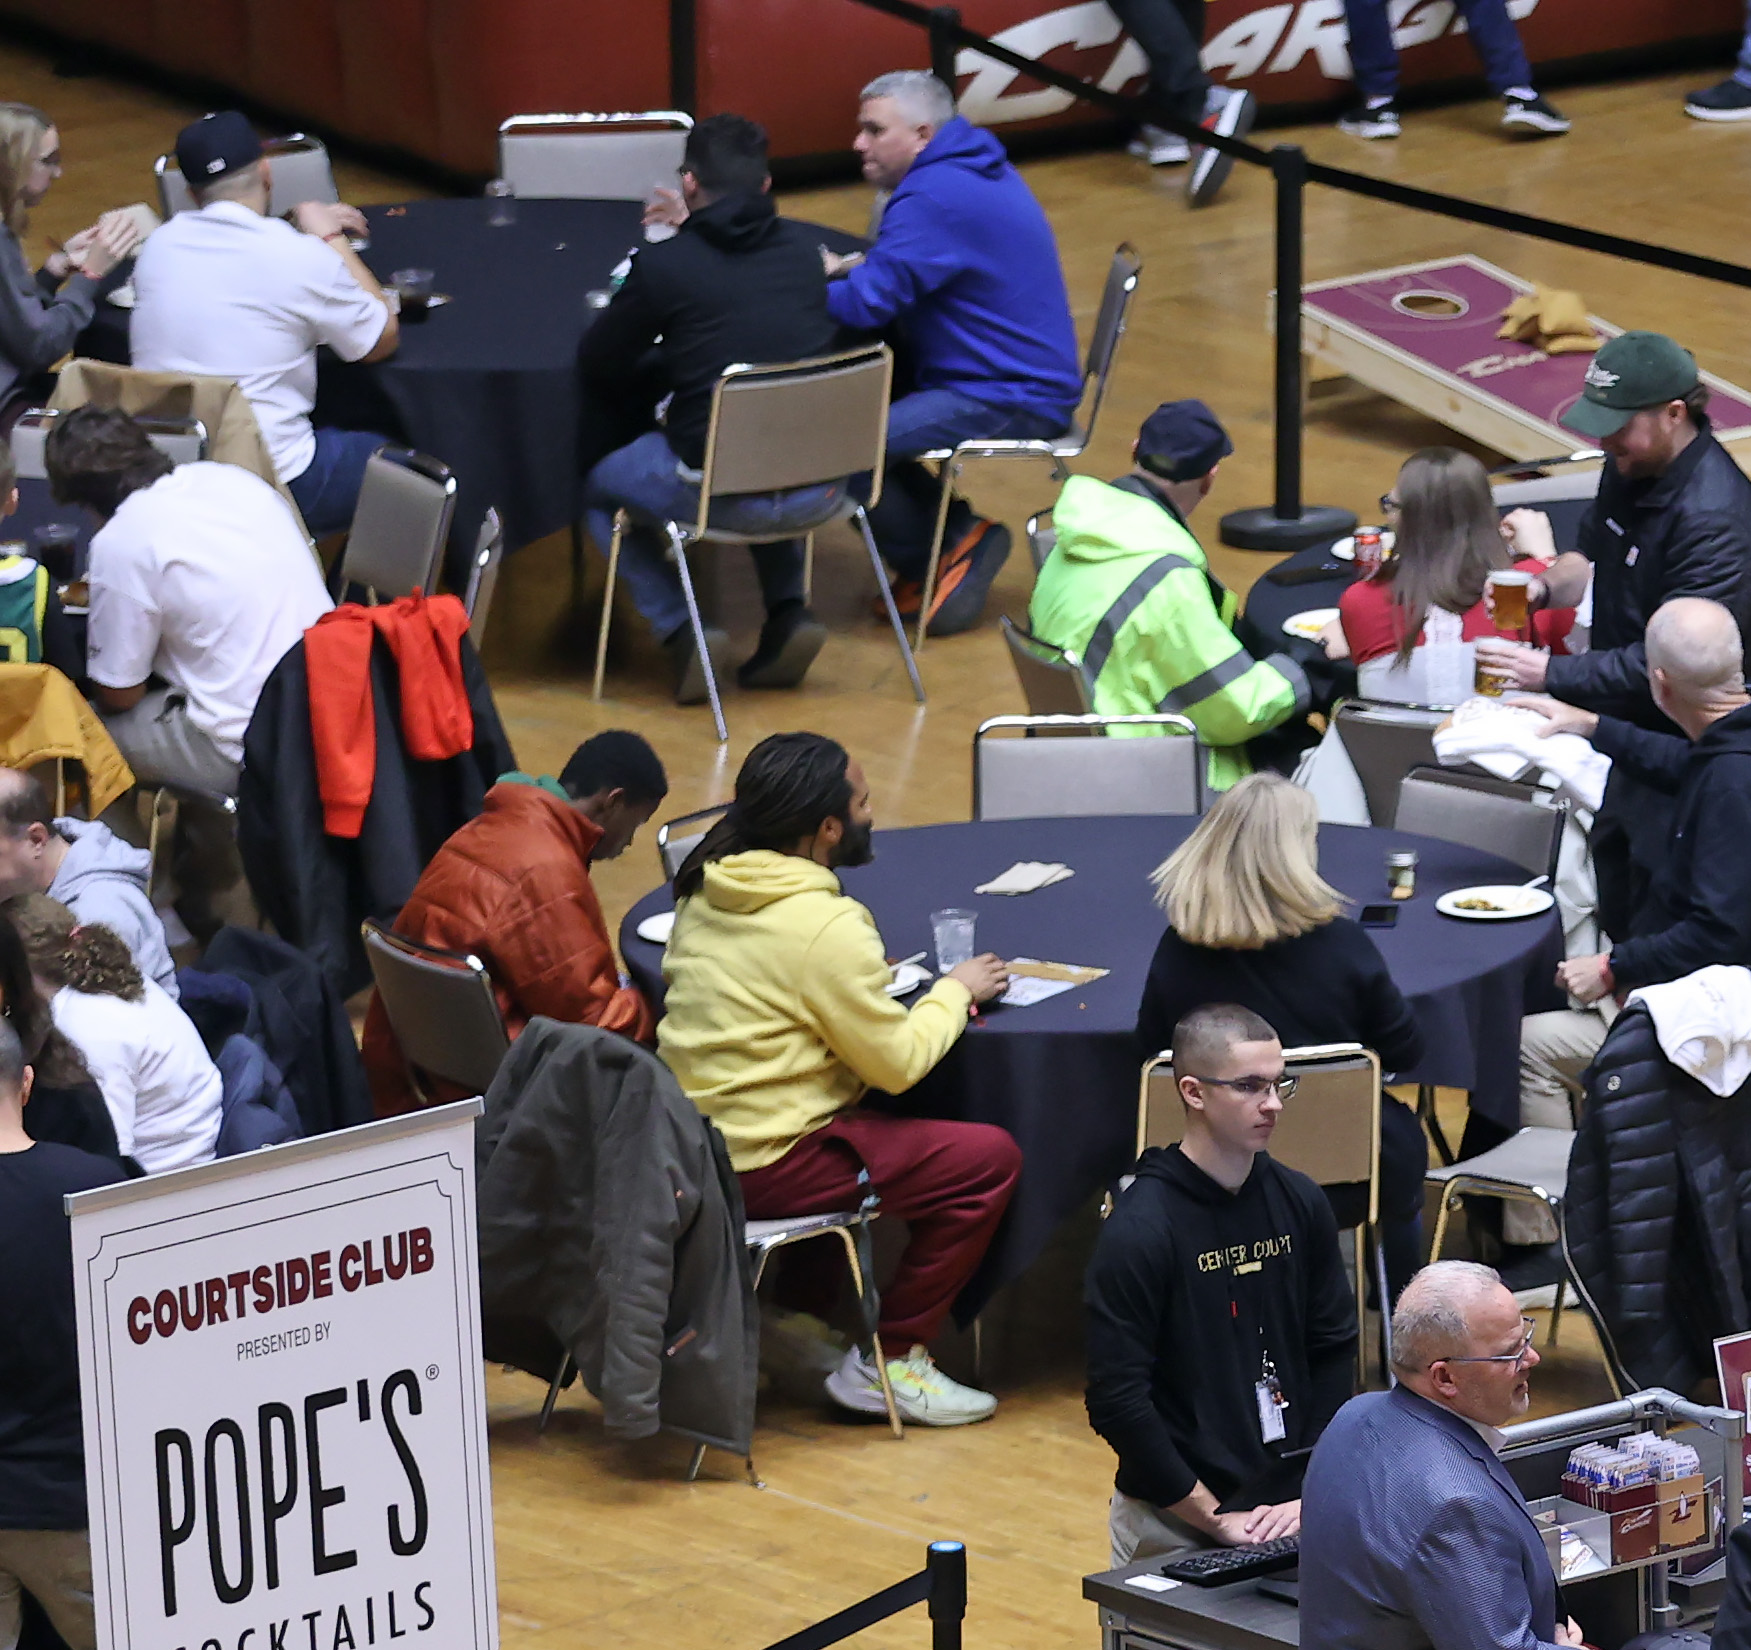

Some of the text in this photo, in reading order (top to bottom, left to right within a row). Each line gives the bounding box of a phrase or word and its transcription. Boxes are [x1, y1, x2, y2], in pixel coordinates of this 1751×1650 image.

[127, 1226, 435, 1345] COURTSIDE CLUB
[236, 1321, 332, 1361] PRESENTED BY
[155, 1368, 429, 1617] POPE'S
